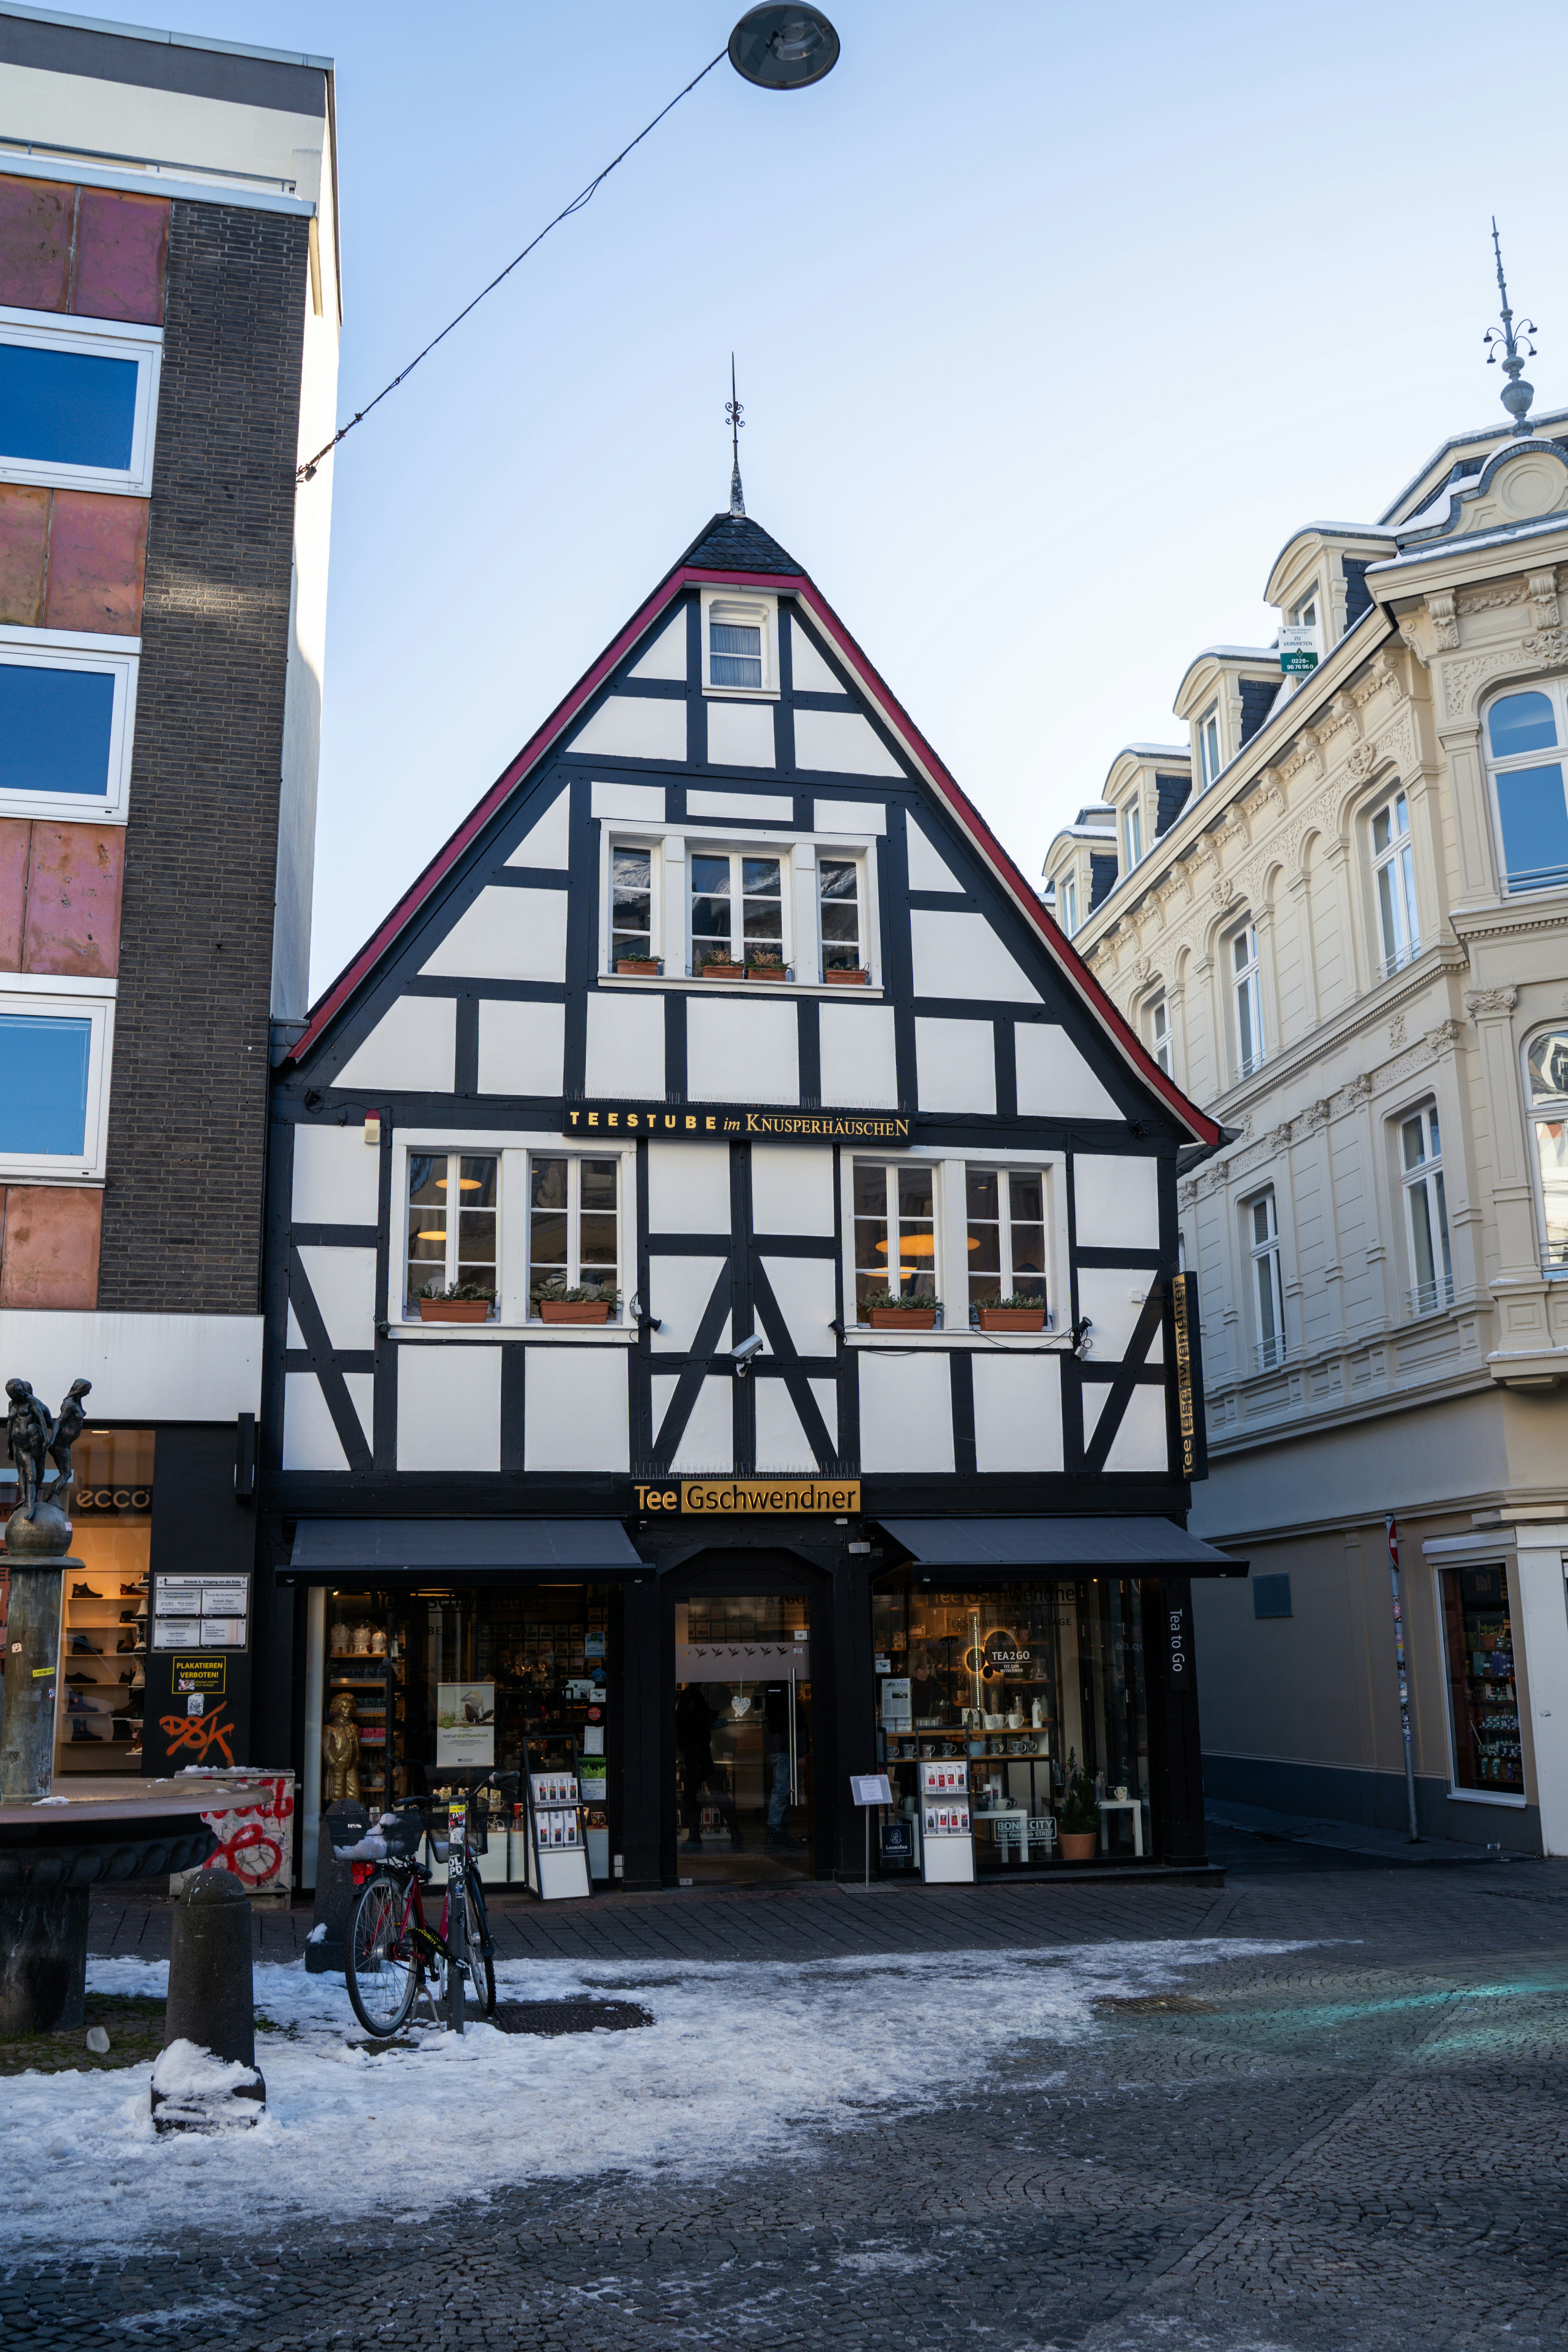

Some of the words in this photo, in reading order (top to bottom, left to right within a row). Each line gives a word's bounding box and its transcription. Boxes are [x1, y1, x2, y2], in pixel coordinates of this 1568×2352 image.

[570, 1111, 716, 1129] TEESTUBE
[723, 1117, 740, 1131] im
[745, 1113, 910, 1136] KNUSPERHÄUSCHEN
[1174, 1280, 1193, 1432] Gschwendner
[1182, 1439, 1194, 1479] Tee
[76, 1490, 150, 1508] ecco
[634, 1485, 677, 1510] Tee
[686, 1484, 856, 1510] Gschwendner
[1170, 1608, 1183, 1631] Tea
[1171, 1635, 1183, 1649] to
[1172, 1653, 1185, 1671] Go
[997, 1821, 1027, 1831] BONN
[1029, 1820, 1053, 1829] CITY
